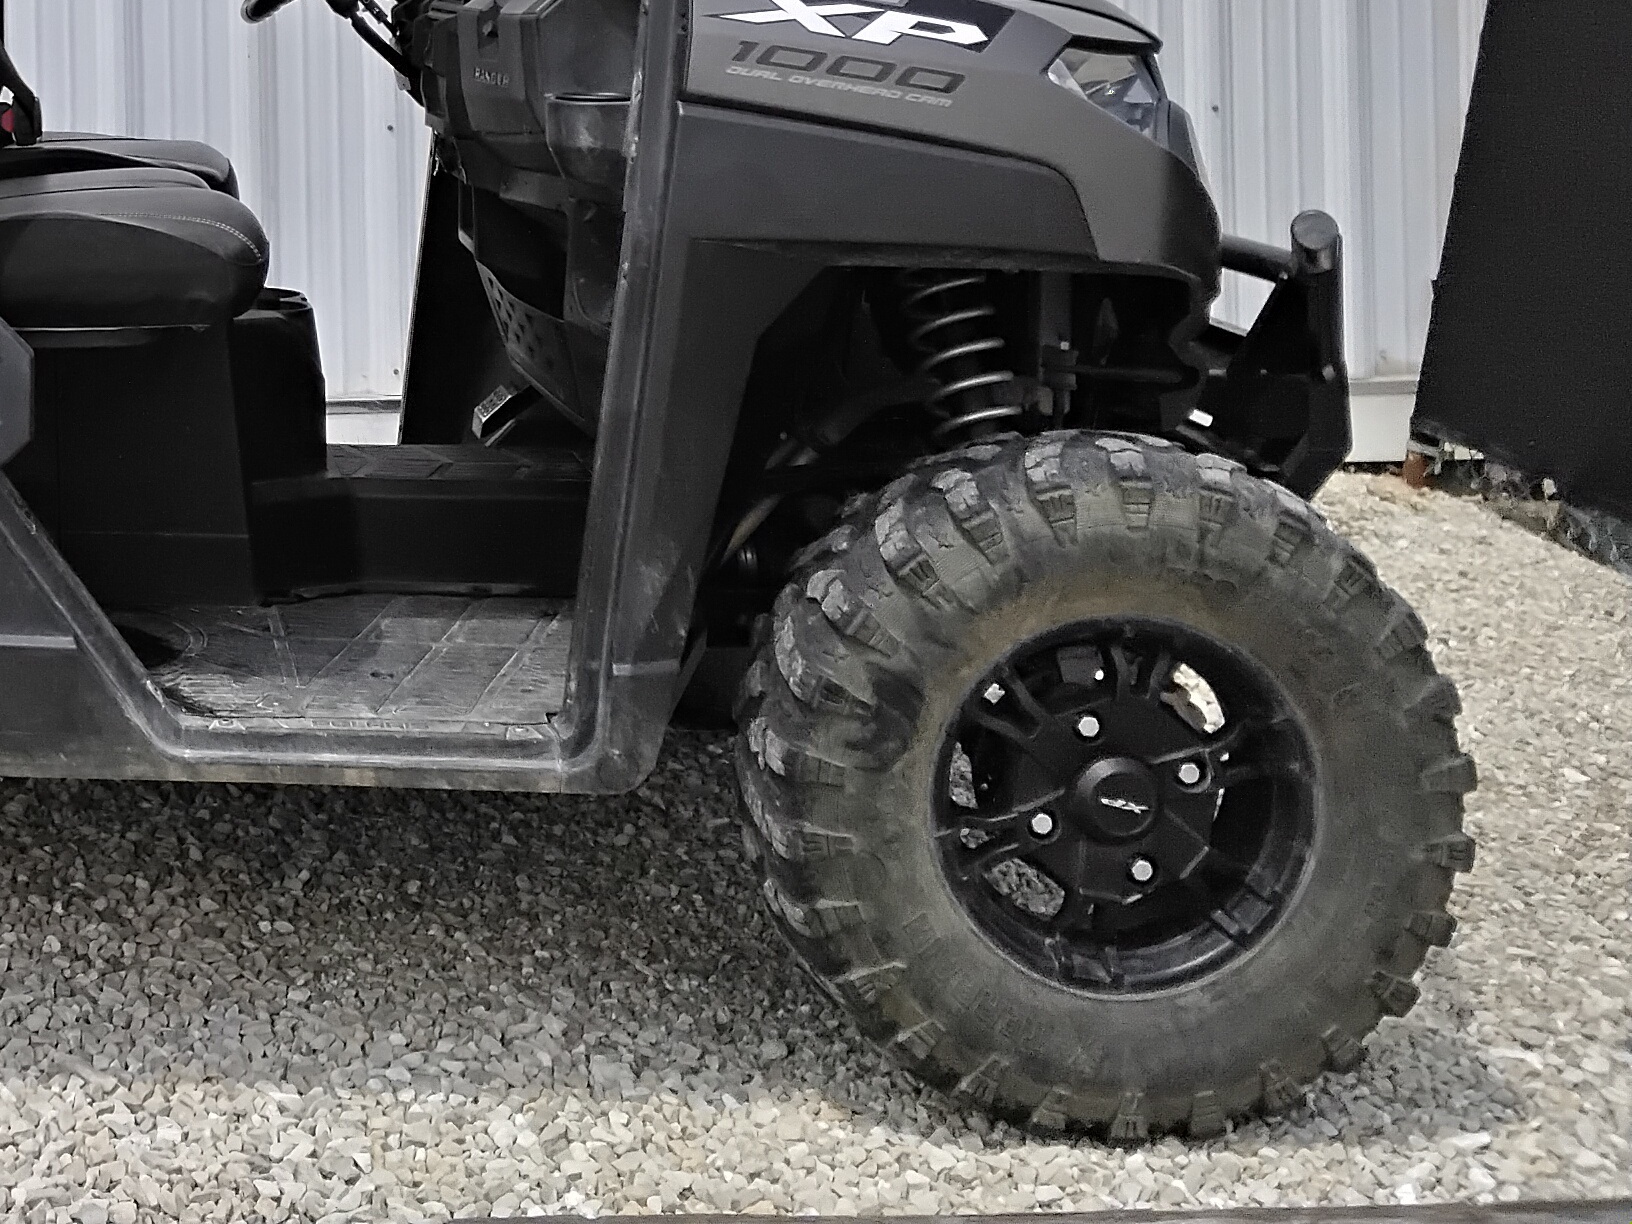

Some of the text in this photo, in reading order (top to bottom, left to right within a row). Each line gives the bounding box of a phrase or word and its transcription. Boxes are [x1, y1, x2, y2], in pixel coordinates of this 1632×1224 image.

[724, 65, 953, 108] DUAL OVERHEAD CAM
[731, 39, 967, 95] 1000
